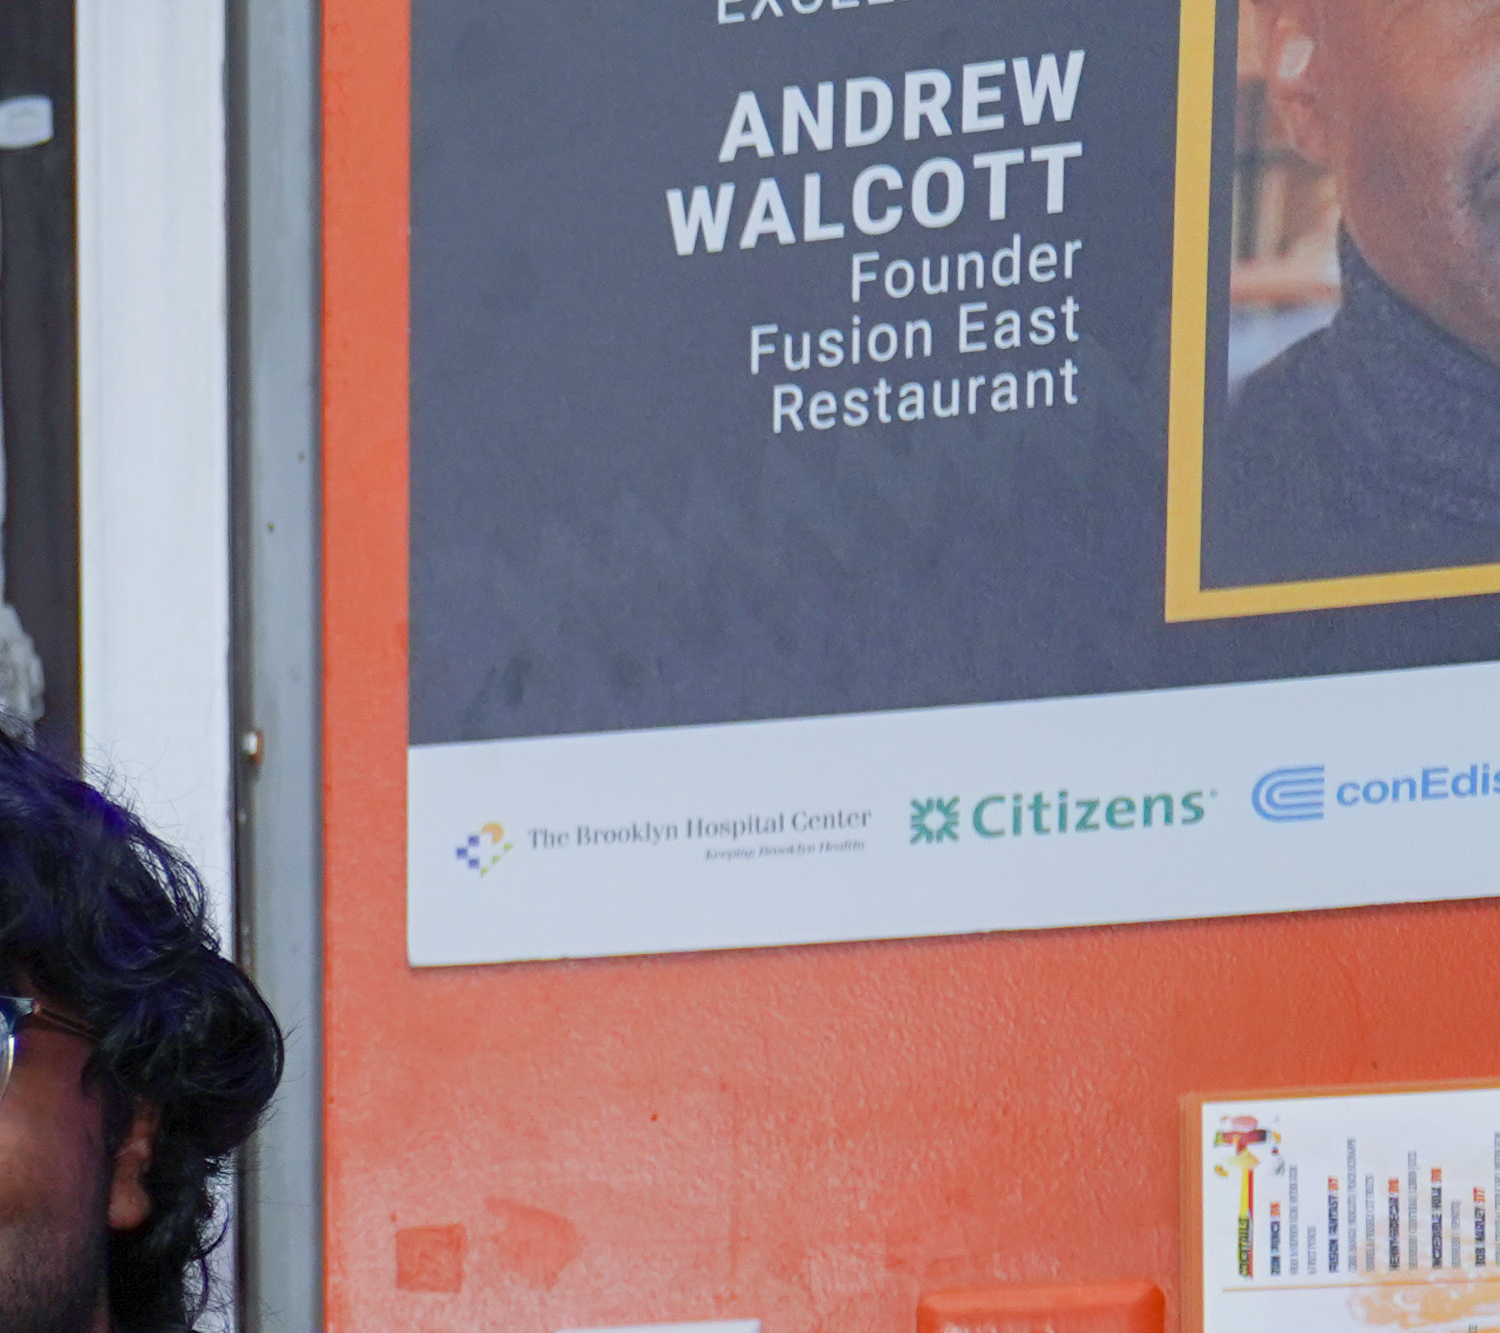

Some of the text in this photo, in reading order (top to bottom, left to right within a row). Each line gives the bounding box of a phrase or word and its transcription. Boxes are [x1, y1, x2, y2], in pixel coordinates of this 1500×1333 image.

[718, 49, 1085, 163] ANDREW
[666, 141, 1083, 256] WALCOTT
[851, 233, 1083, 302] Founder
[750, 296, 1080, 375] Fusion East
[772, 358, 1079, 434] Restaurant
[528, 807, 873, 850] The Brooklyn Hospital Center
[972, 787, 1205, 838] Citizens
[1238, 1216, 1250, 1277] COCKTAILS
[1328, 1195, 1338, 1236] FANTASY
